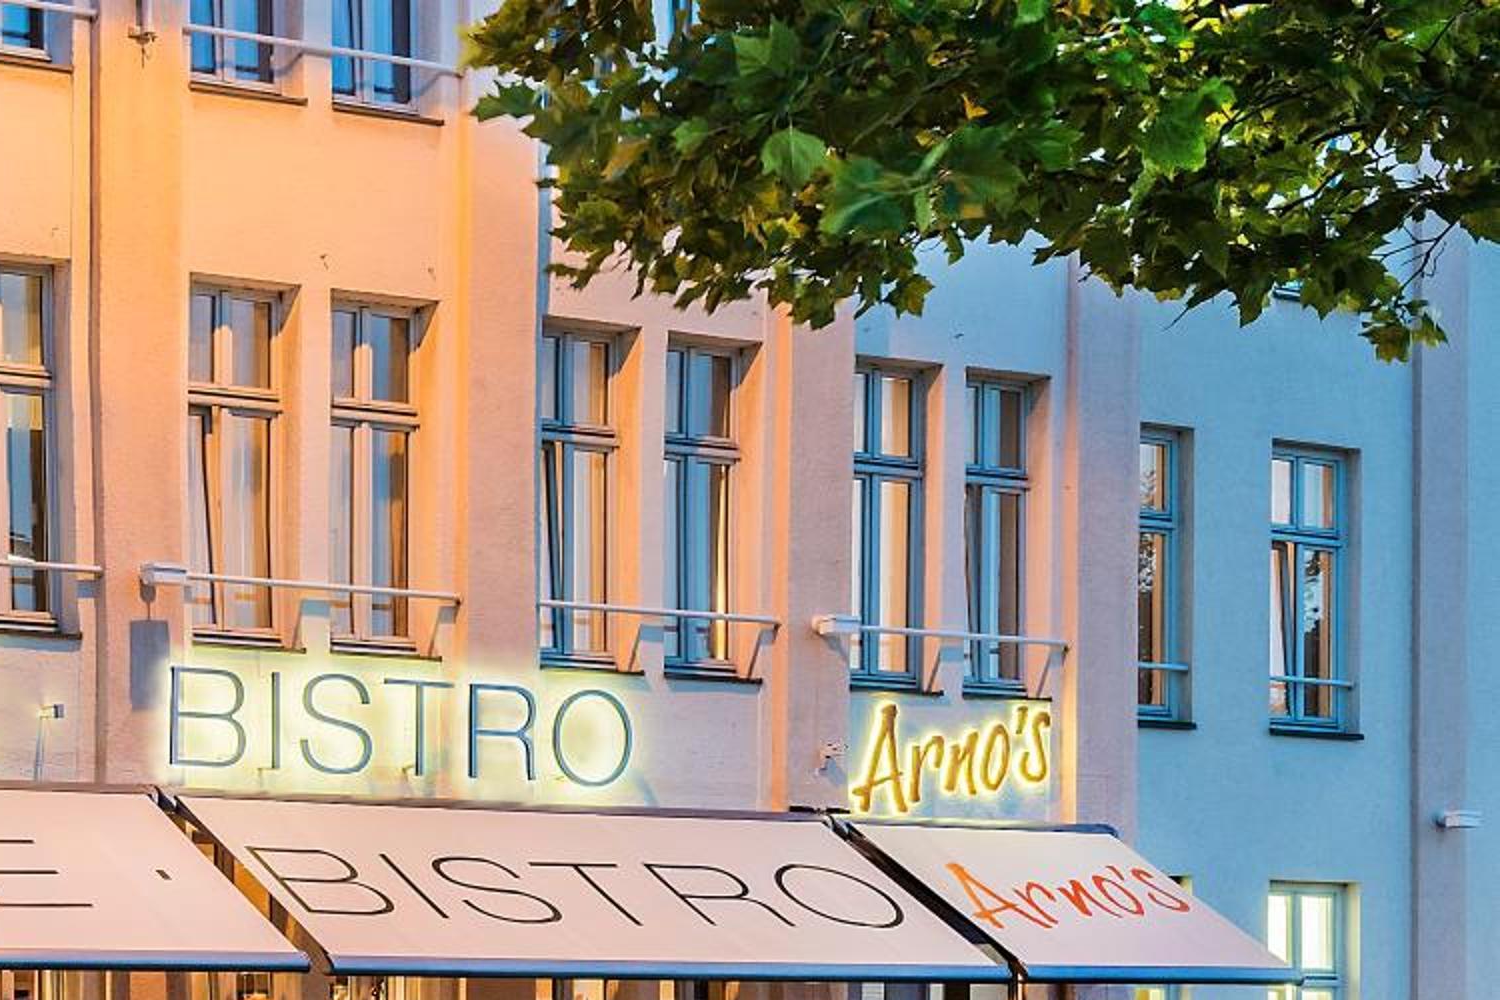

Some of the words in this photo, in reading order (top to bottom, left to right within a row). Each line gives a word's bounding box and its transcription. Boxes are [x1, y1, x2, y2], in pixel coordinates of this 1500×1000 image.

[169, 665, 633, 787] BISTRO
[852, 704, 1050, 812] Arno's
[244, 845, 904, 928] BISTRO
[945, 862, 1191, 929] Arno's
